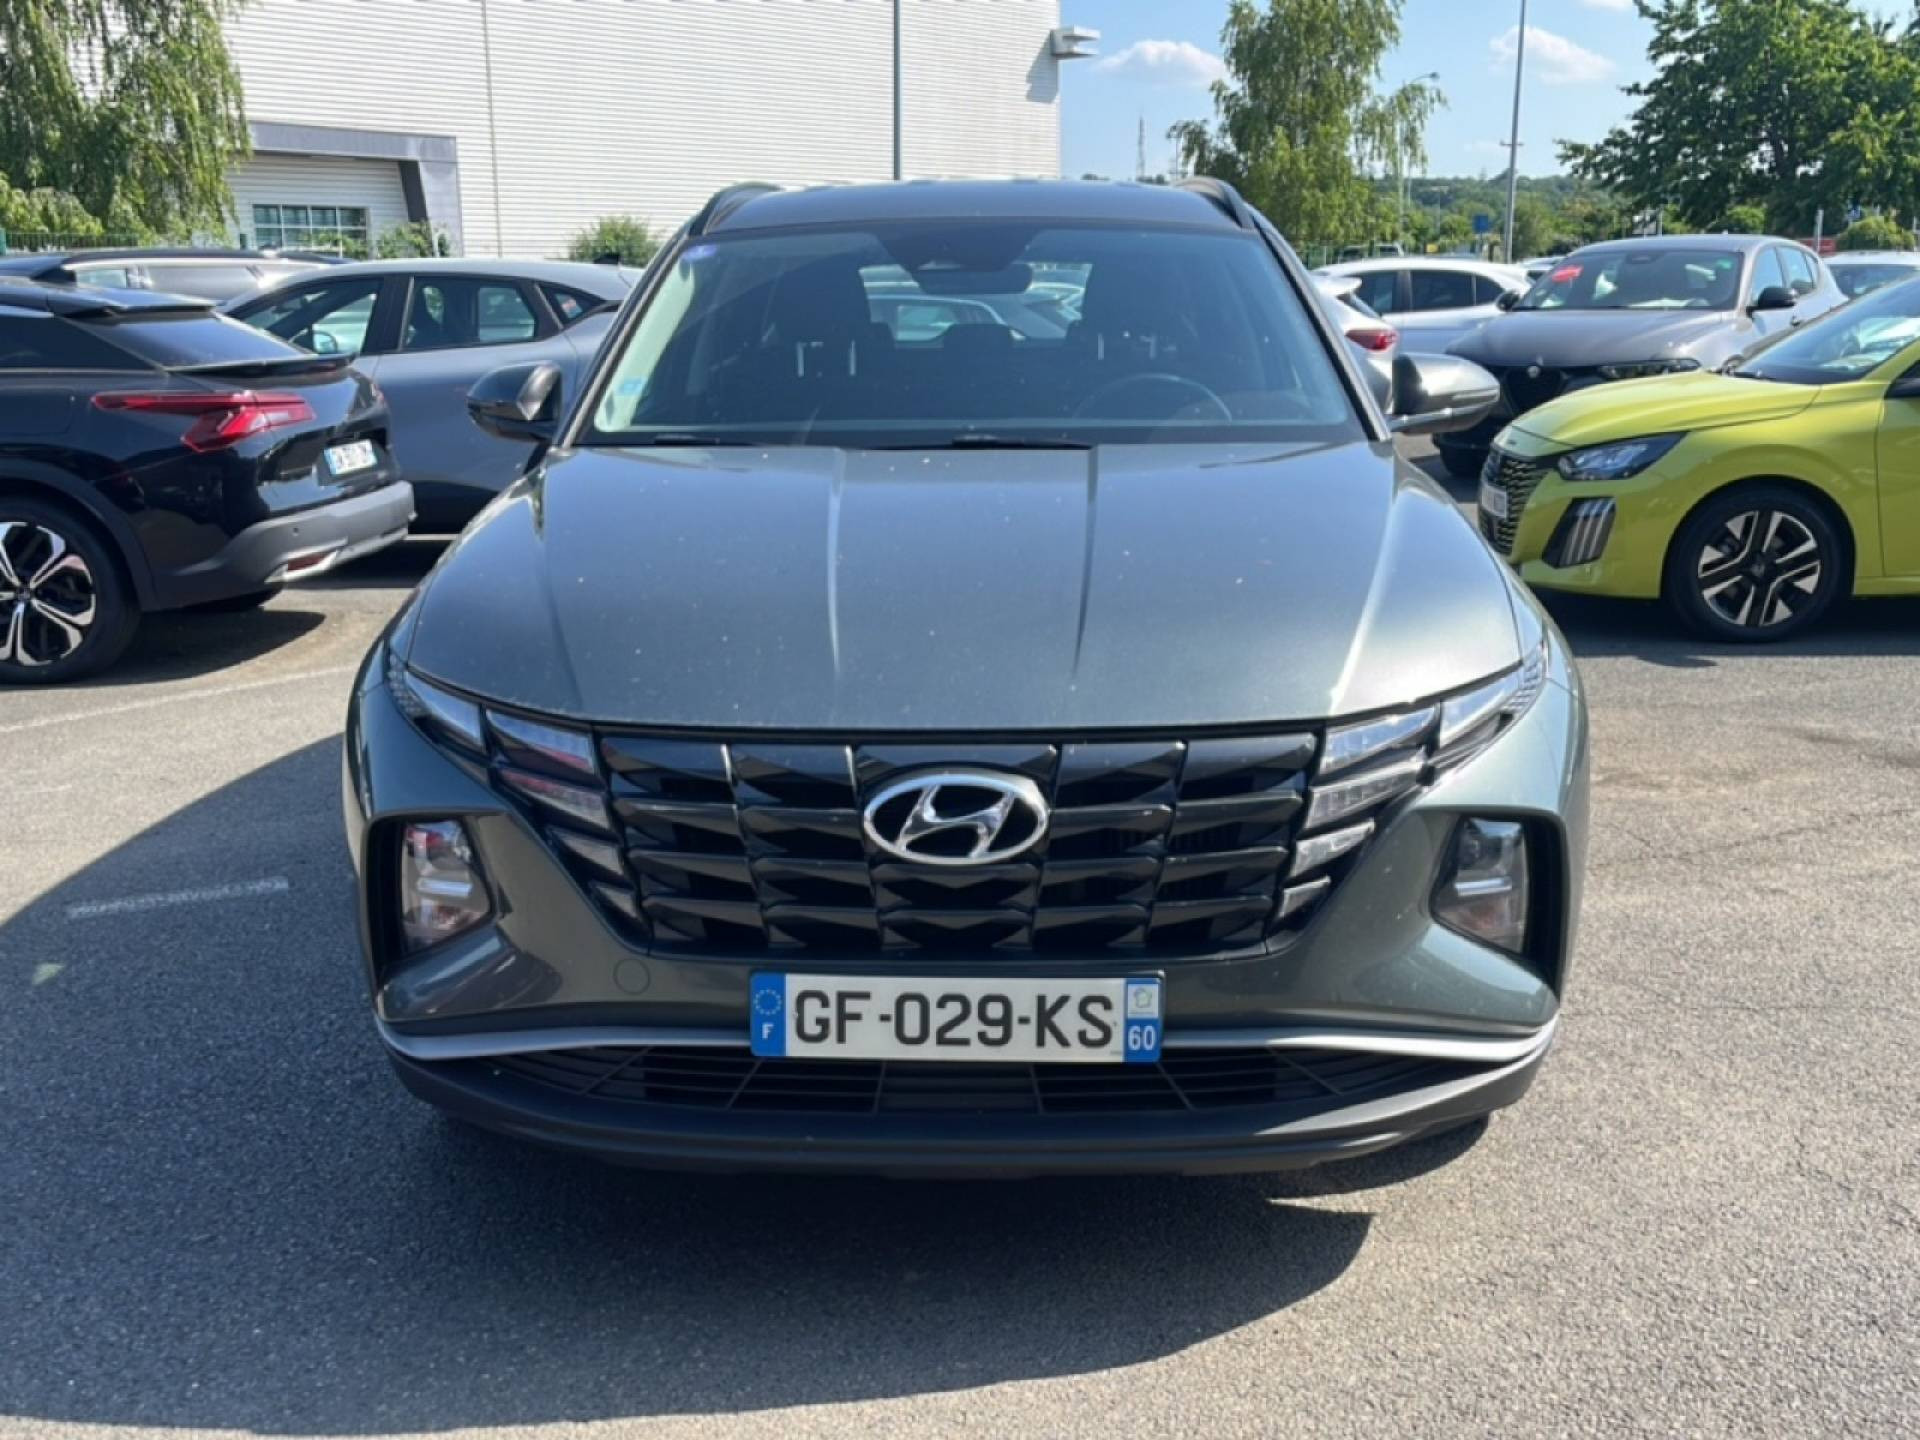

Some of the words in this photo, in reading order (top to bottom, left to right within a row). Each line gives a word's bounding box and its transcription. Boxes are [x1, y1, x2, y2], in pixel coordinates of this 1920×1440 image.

[761, 1023, 774, 1039] F
[794, 989, 1113, 1049] GF-029-KS
[1127, 1024, 1157, 1051] 60
